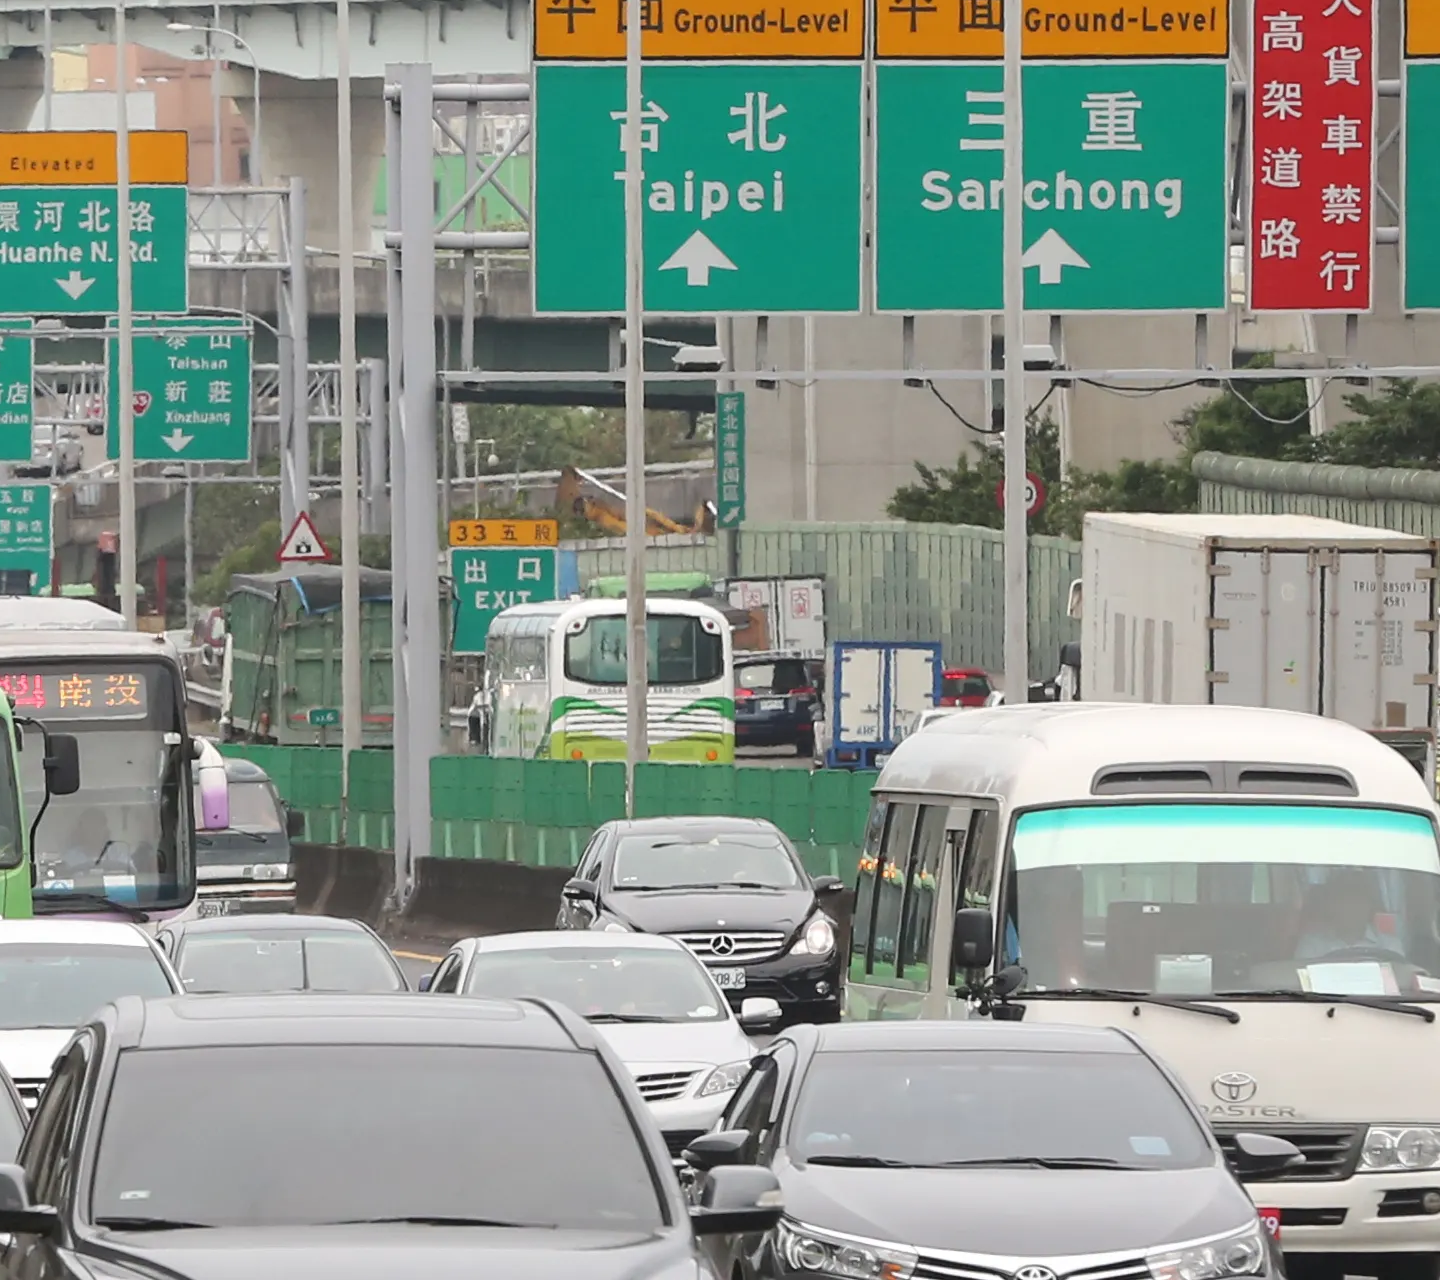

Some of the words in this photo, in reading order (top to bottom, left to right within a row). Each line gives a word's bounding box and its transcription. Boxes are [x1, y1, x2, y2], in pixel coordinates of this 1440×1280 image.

[674, 8, 849, 35] Ground-Level
[1025, 5, 1216, 34] Ground-Level
[611, 93, 787, 153] 台北
[960, 91, 1143, 152] 三重
[1261, 10, 1304, 260] 高架道路
[10, 157, 96, 171] Elevated
[457, 524, 486, 541] 33
[500, 524, 550, 541] 五股
[464, 557, 541, 583] 出口
[475, 591, 531, 610] EXIT
[60, 673, 140, 708] 南投
